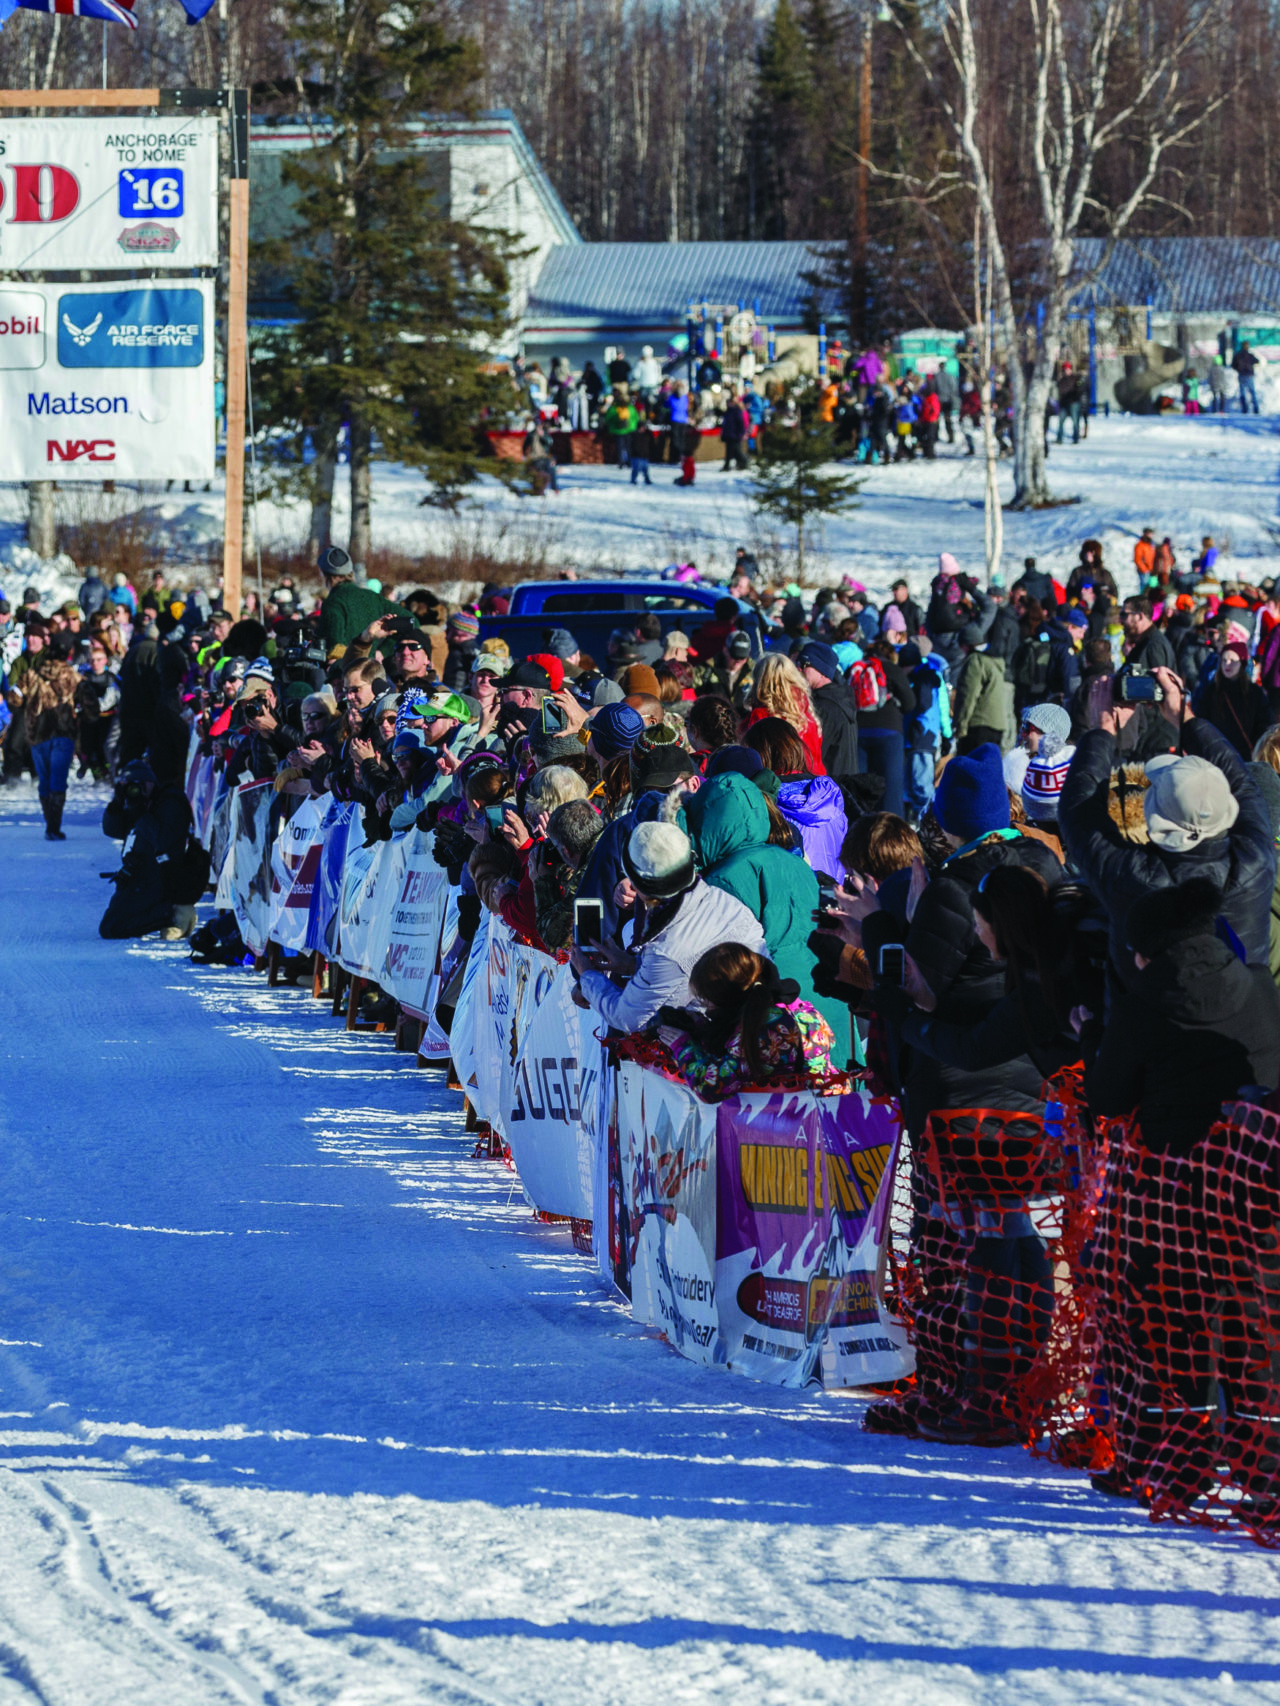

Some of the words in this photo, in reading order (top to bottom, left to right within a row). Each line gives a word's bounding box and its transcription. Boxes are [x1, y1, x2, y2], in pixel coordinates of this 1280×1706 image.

[105, 133, 198, 149] ANCHORAGE
[117, 148, 137, 162] TO
[142, 148, 186, 162] NOME
[107, 325, 138, 336] AIR
[141, 324, 199, 336] FORCE
[111, 335, 194, 346] RESERVE
[28, 391, 128, 415] Matson
[47, 439, 116, 462] NAC
